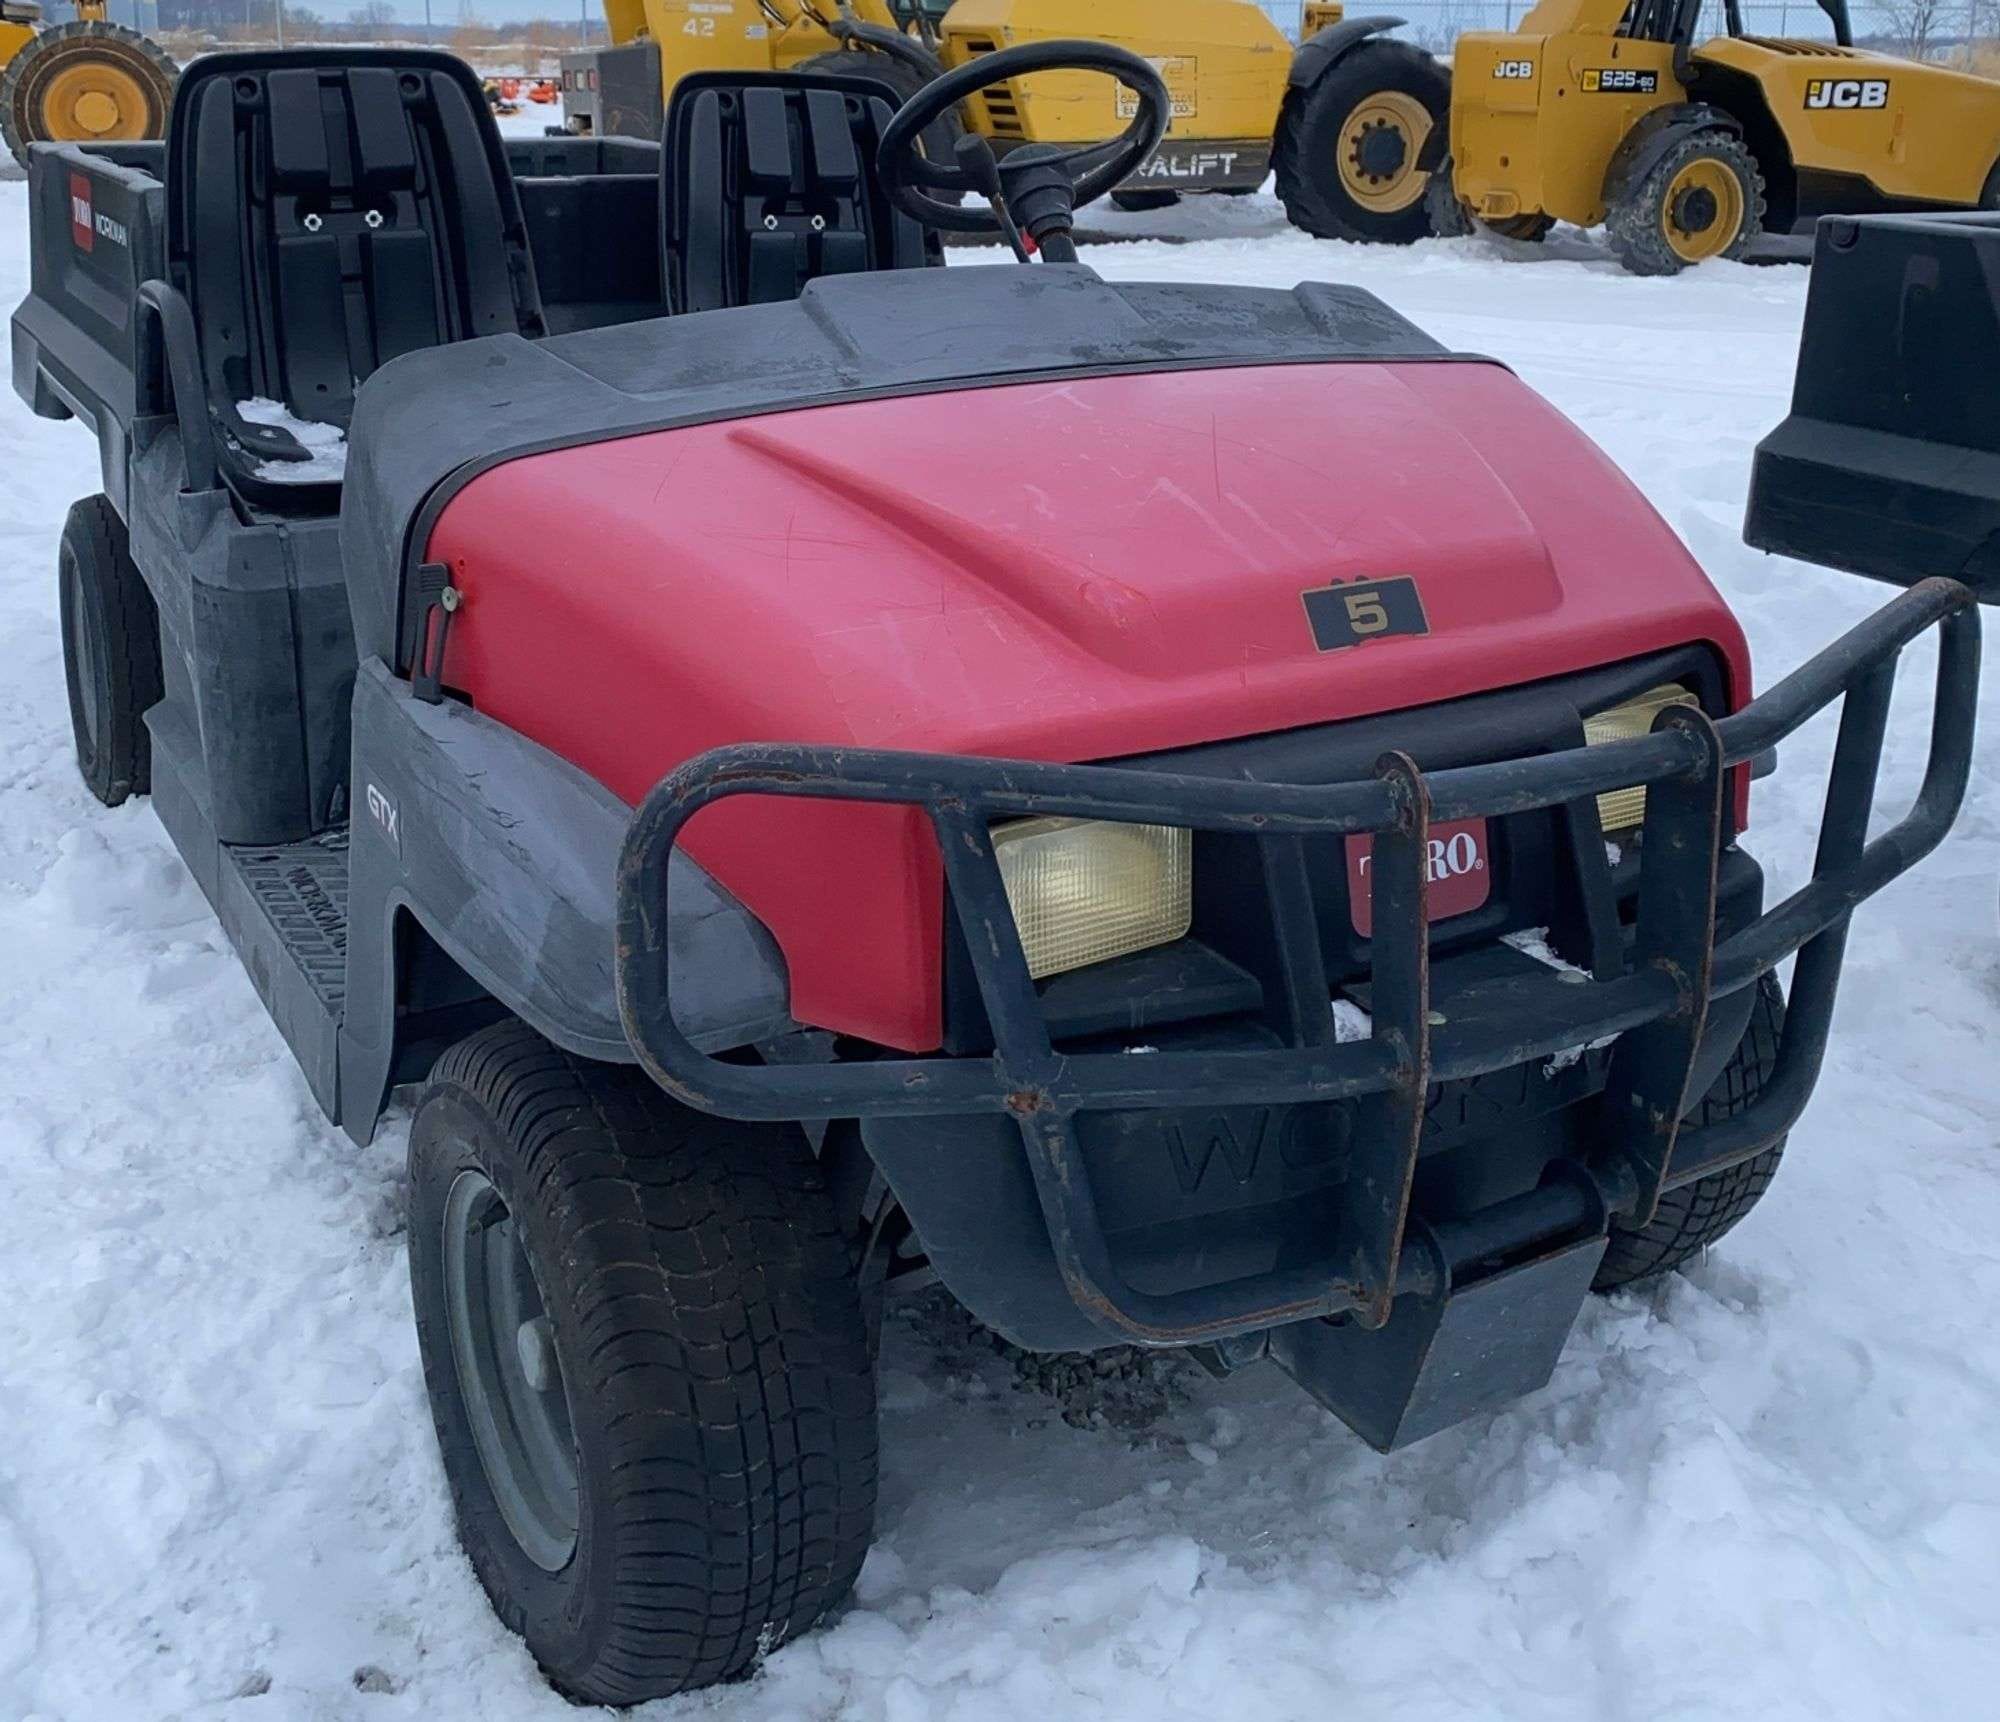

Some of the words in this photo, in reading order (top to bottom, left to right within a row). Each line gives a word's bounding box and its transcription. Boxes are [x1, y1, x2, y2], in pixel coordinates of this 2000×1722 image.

[682, 17, 715, 37] 42
[1494, 61, 1532, 78] JCB
[1808, 80, 1888, 108] JCB
[1343, 591, 1389, 635] 5
[367, 783, 400, 842] GTX
[1360, 831, 1478, 882] RO
